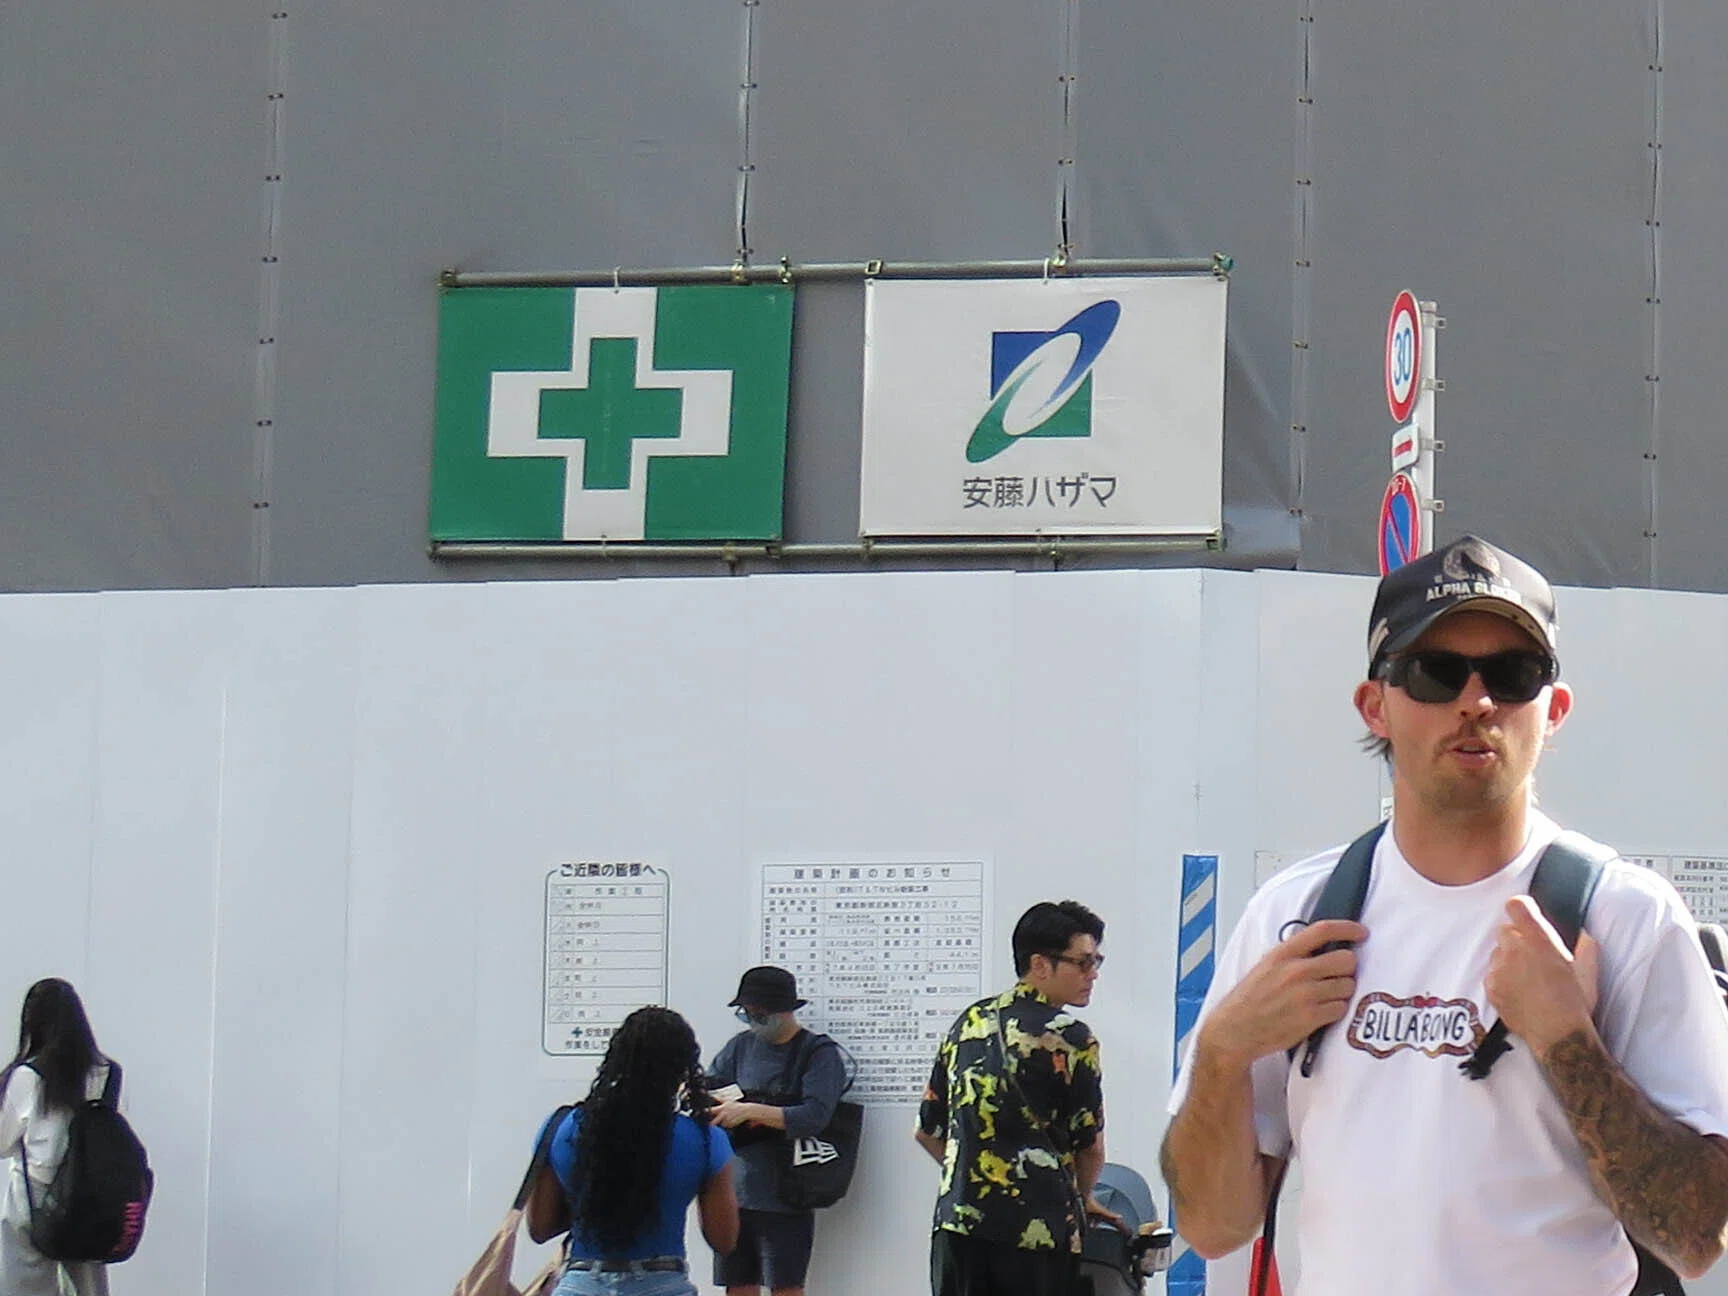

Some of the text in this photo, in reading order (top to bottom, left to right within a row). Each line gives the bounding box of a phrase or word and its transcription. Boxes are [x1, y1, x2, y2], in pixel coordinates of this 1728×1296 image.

[1394, 326, 1412, 387] 30
[962, 472, 1117, 509] 安藤ハザマ
[1426, 581, 1472, 603] ALPHA
[1363, 1008, 1468, 1044] BILLABONG
